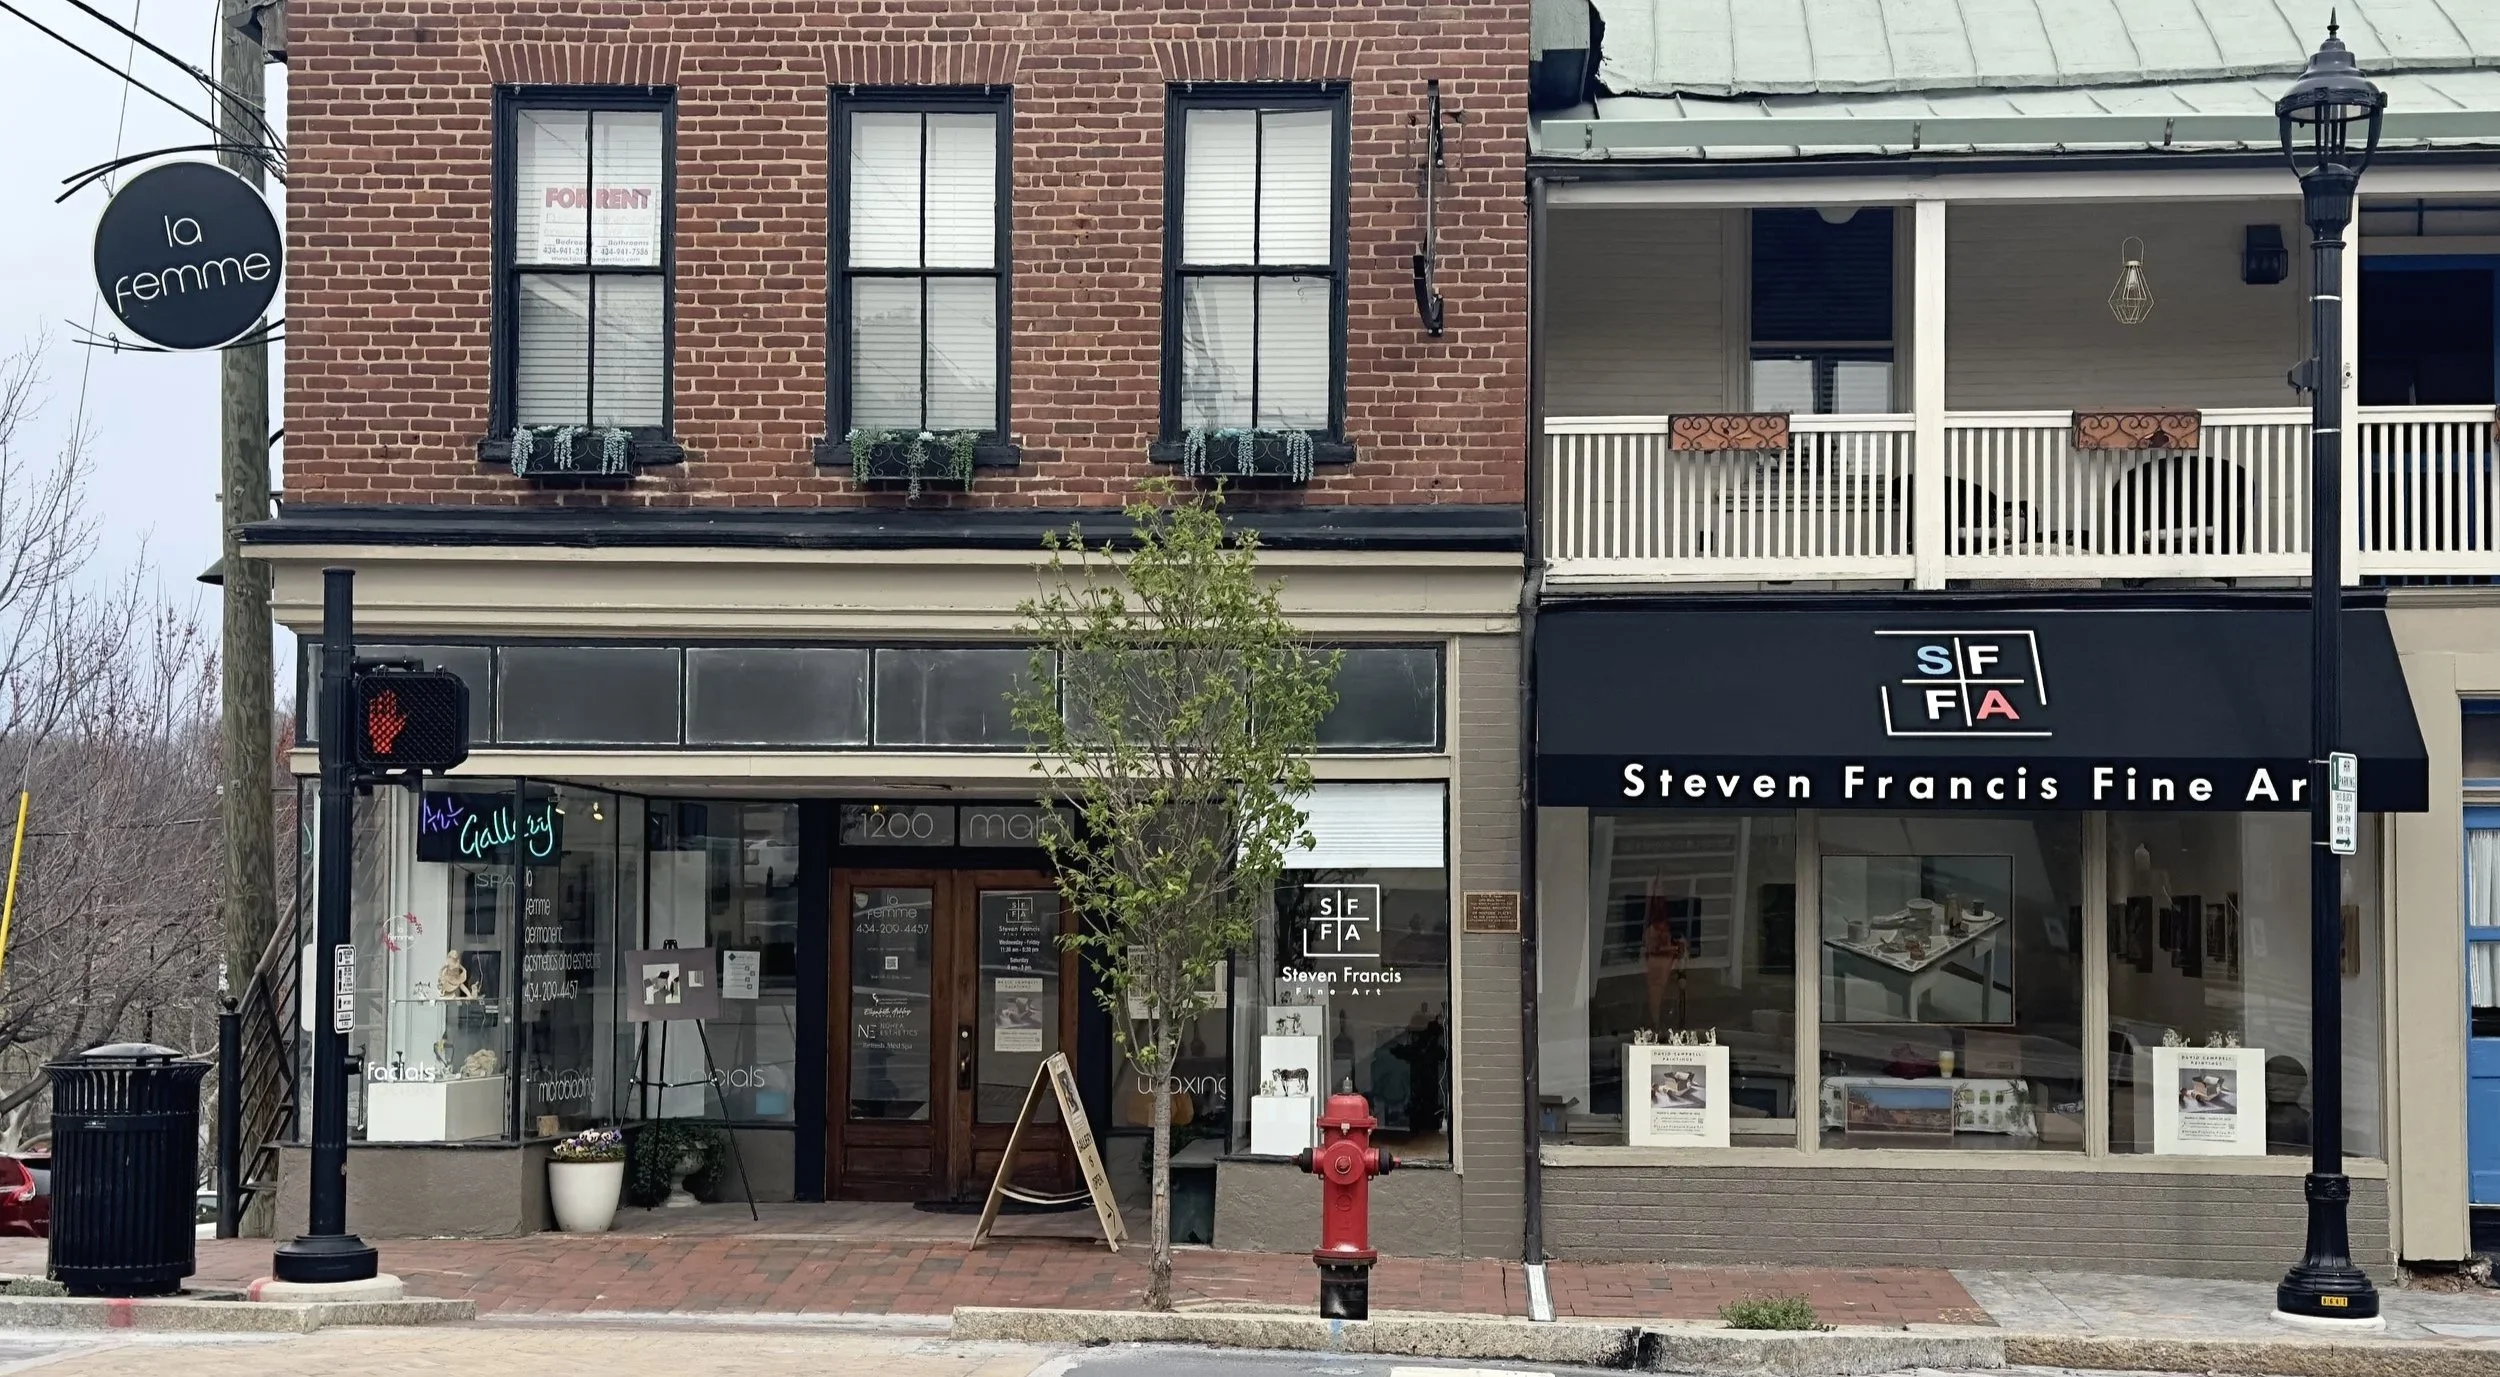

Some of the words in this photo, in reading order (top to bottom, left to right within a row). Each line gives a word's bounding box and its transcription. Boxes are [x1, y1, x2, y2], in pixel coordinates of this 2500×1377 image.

[546, 188, 587, 208] FOR
[596, 188, 651, 209] RENT
[164, 215, 203, 248] la
[115, 252, 271, 314] femme
[1623, 763, 1810, 798] Steven
[1844, 766, 2058, 800] Francis
[2093, 767, 2213, 801] Fine
[2245, 768, 2307, 801] Ar
[2339, 775, 2356, 789] PARKING
[422, 797, 465, 834] Art
[860, 812, 934, 839] 1200
[476, 873, 515, 888] SPA
[525, 898, 551, 920] femme
[886, 894, 899, 907] la
[867, 906, 917, 920] femme
[524, 926, 563, 948] permanent
[1281, 966, 1338, 983] Steven
[1343, 966, 1402, 984] Francis
[1295, 987, 1337, 996] Fine
[1351, 987, 1382, 996] Art
[366, 1060, 436, 1082] facials
[687, 1064, 765, 1088] acials
